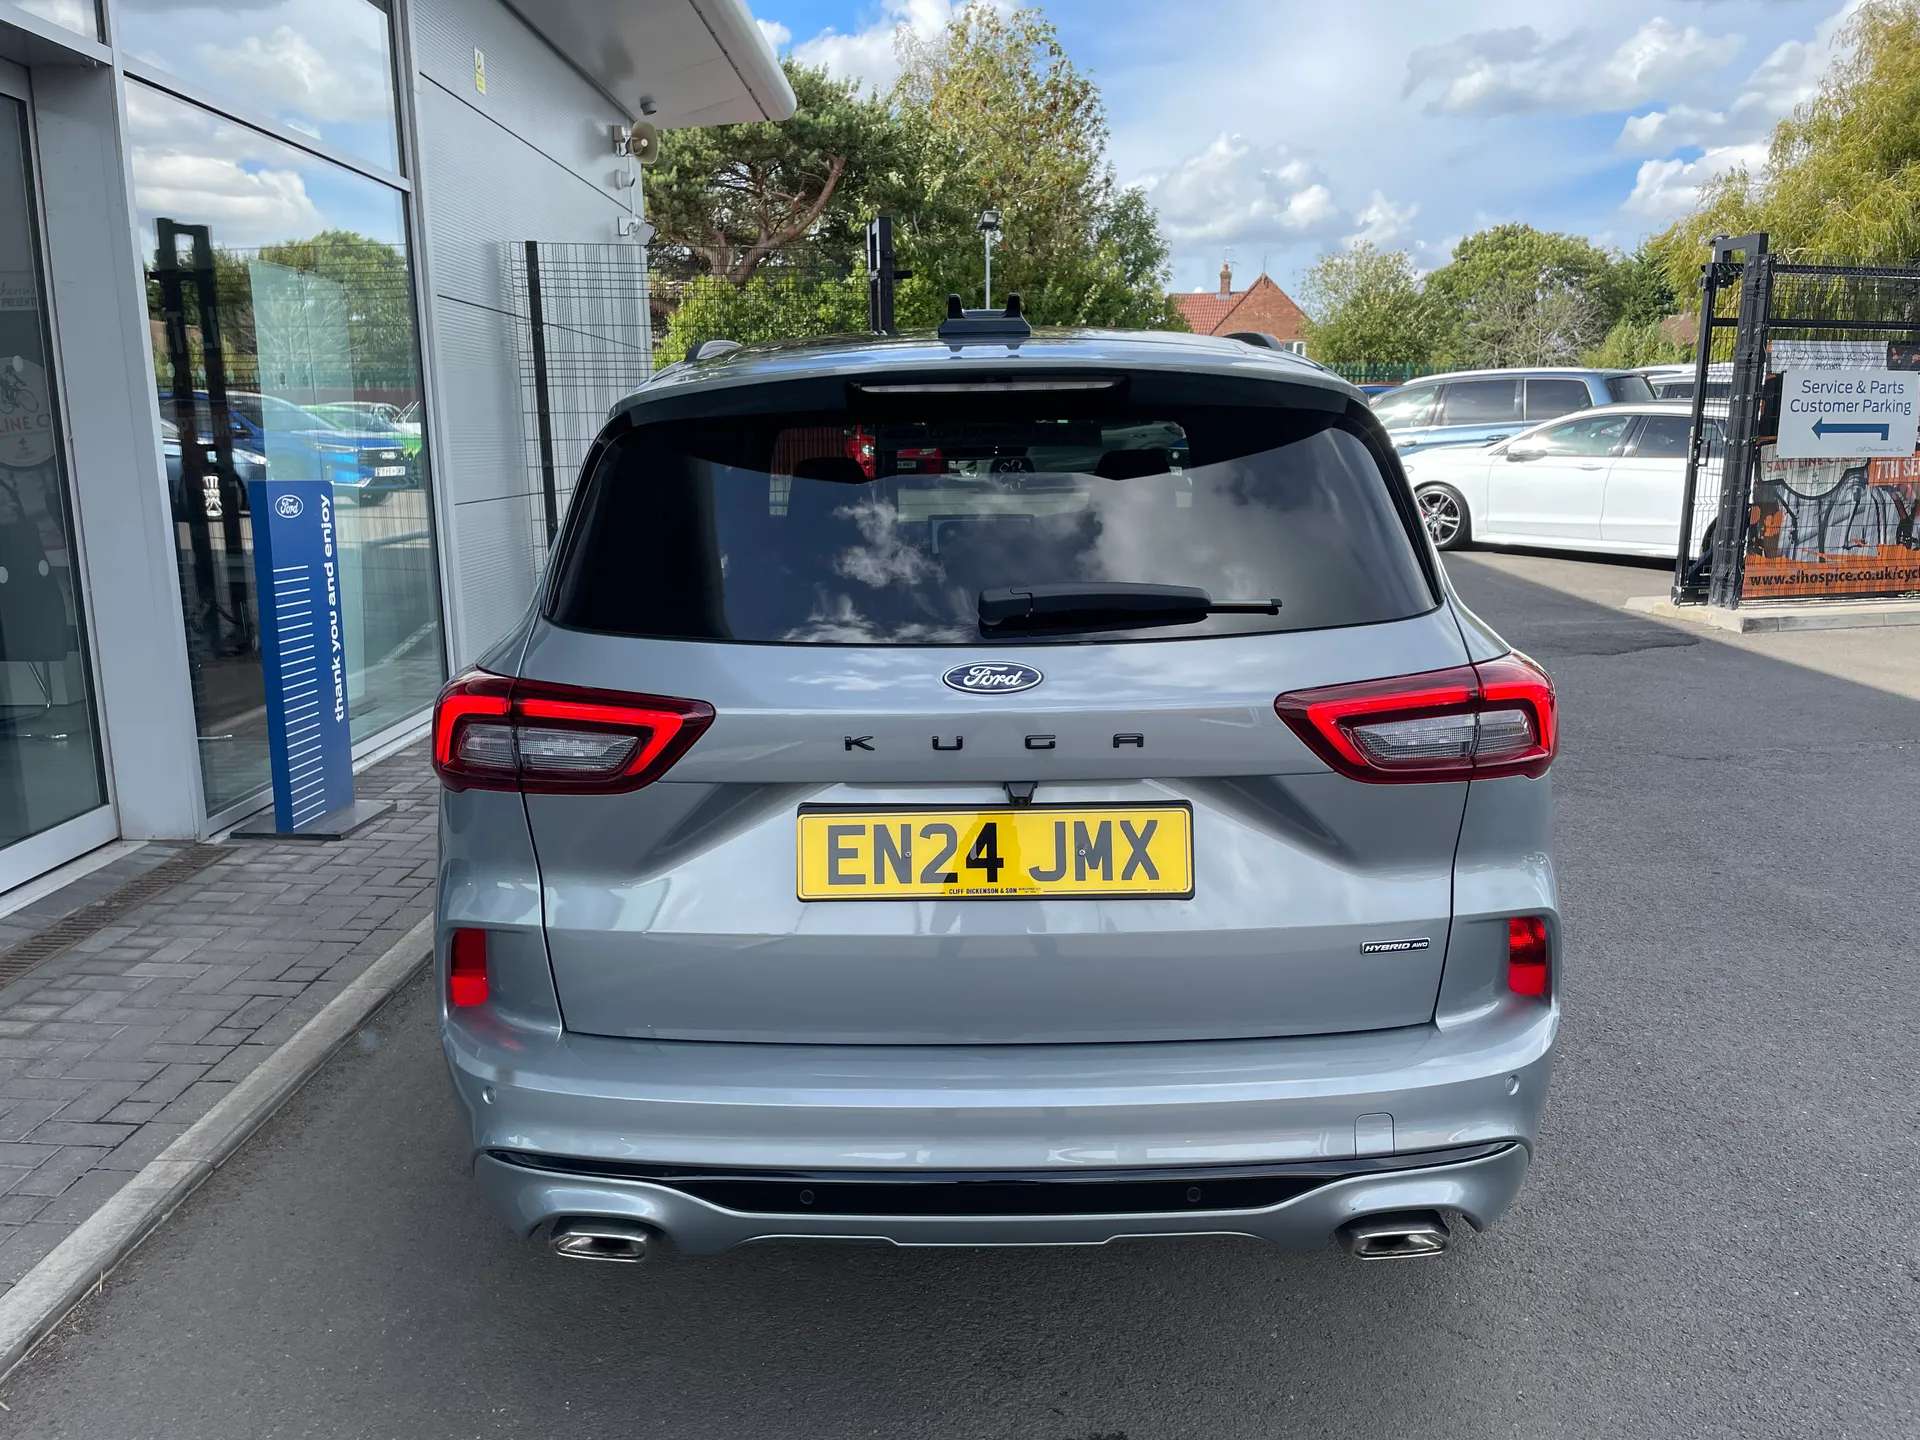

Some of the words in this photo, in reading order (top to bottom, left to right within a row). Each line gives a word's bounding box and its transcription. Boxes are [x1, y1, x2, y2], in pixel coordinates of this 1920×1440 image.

[1801, 380, 1853, 393] Service
[1856, 380, 1866, 394] &
[1870, 381, 1905, 393] Parts
[1790, 399, 1859, 413] Customer
[1862, 399, 1912, 415] Parking
[1875, 459, 1900, 479] 7TH
[280, 497, 299, 514] Ford
[320, 494, 333, 557] enjoy
[323, 561, 337, 607] and
[329, 611, 342, 652] you
[963, 666, 1023, 687] Ford
[331, 656, 345, 723] thank
[844, 732, 1144, 752] KUGA
[827, 822, 1004, 885] EN24
[1028, 819, 1160, 882] JMX
[1364, 943, 1410, 952] HYBRID
